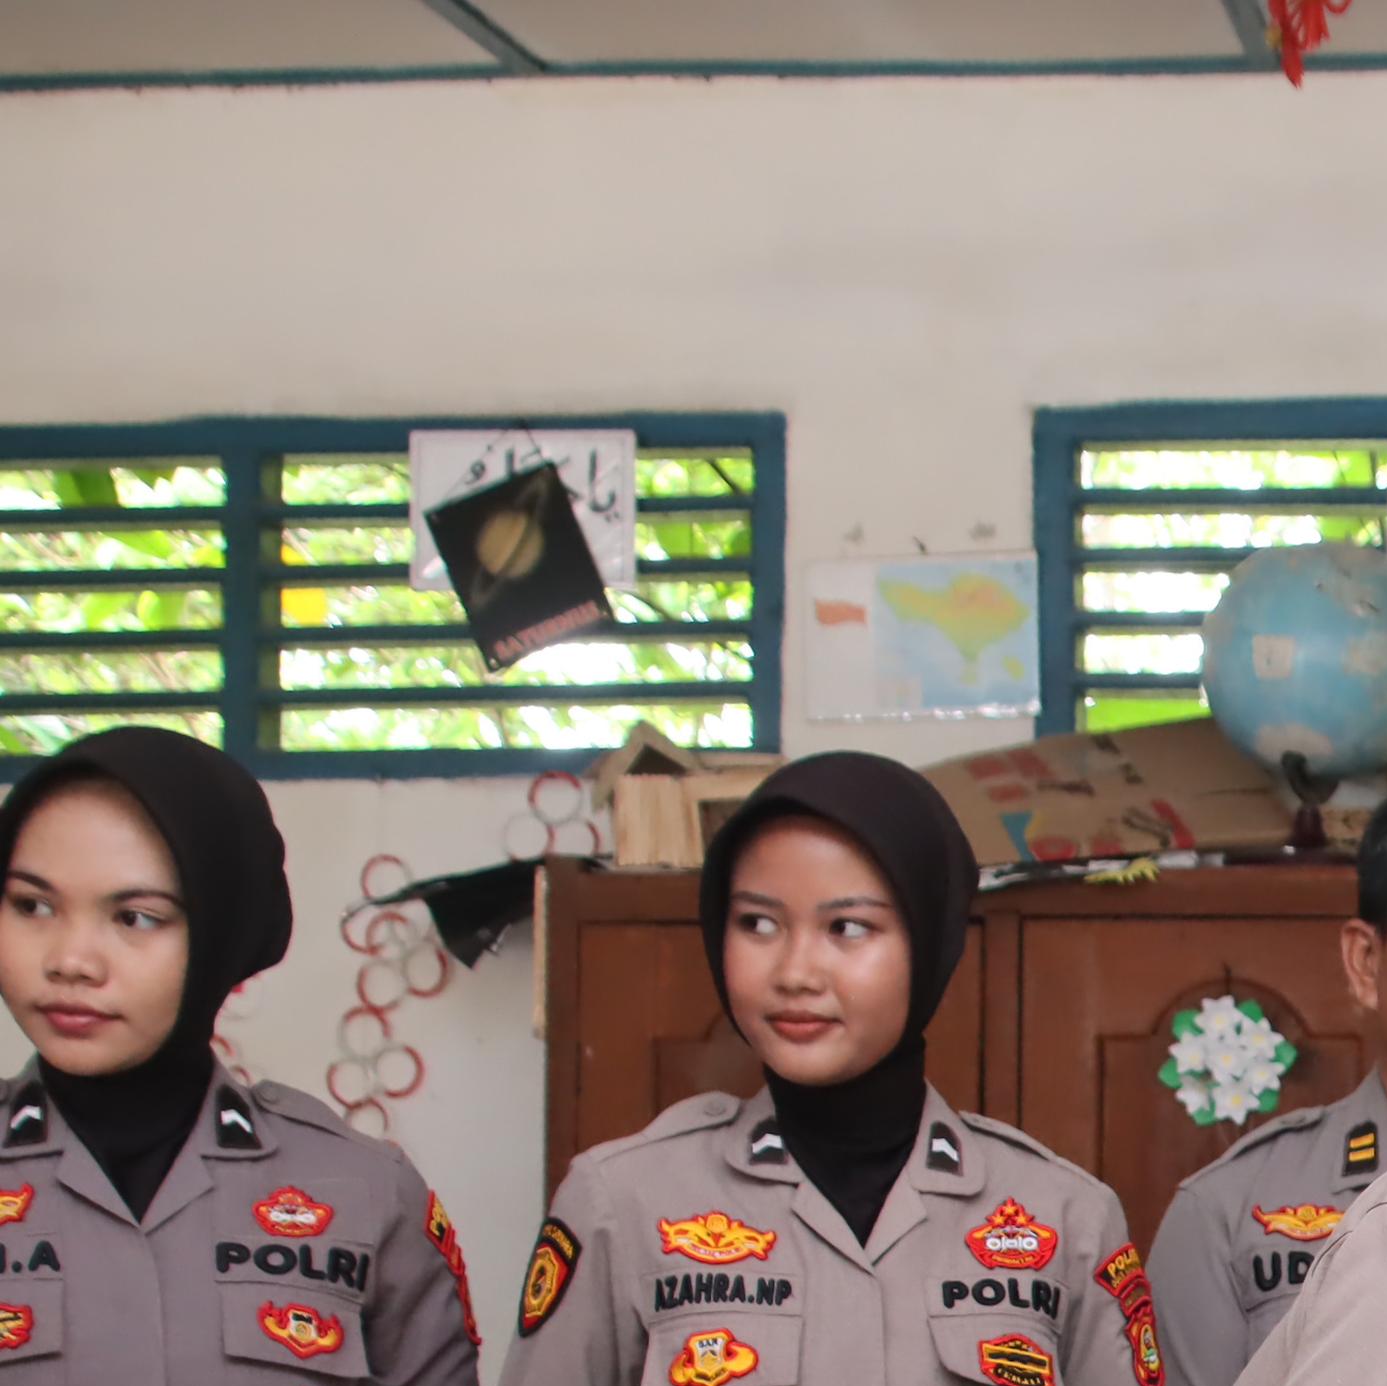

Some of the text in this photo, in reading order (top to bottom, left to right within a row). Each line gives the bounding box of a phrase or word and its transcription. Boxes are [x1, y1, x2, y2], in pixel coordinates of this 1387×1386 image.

[215, 1241, 370, 1292] POLRI
[654, 1272, 792, 1312] AZAHRA.NP
[942, 1278, 1061, 1321] POLRI
